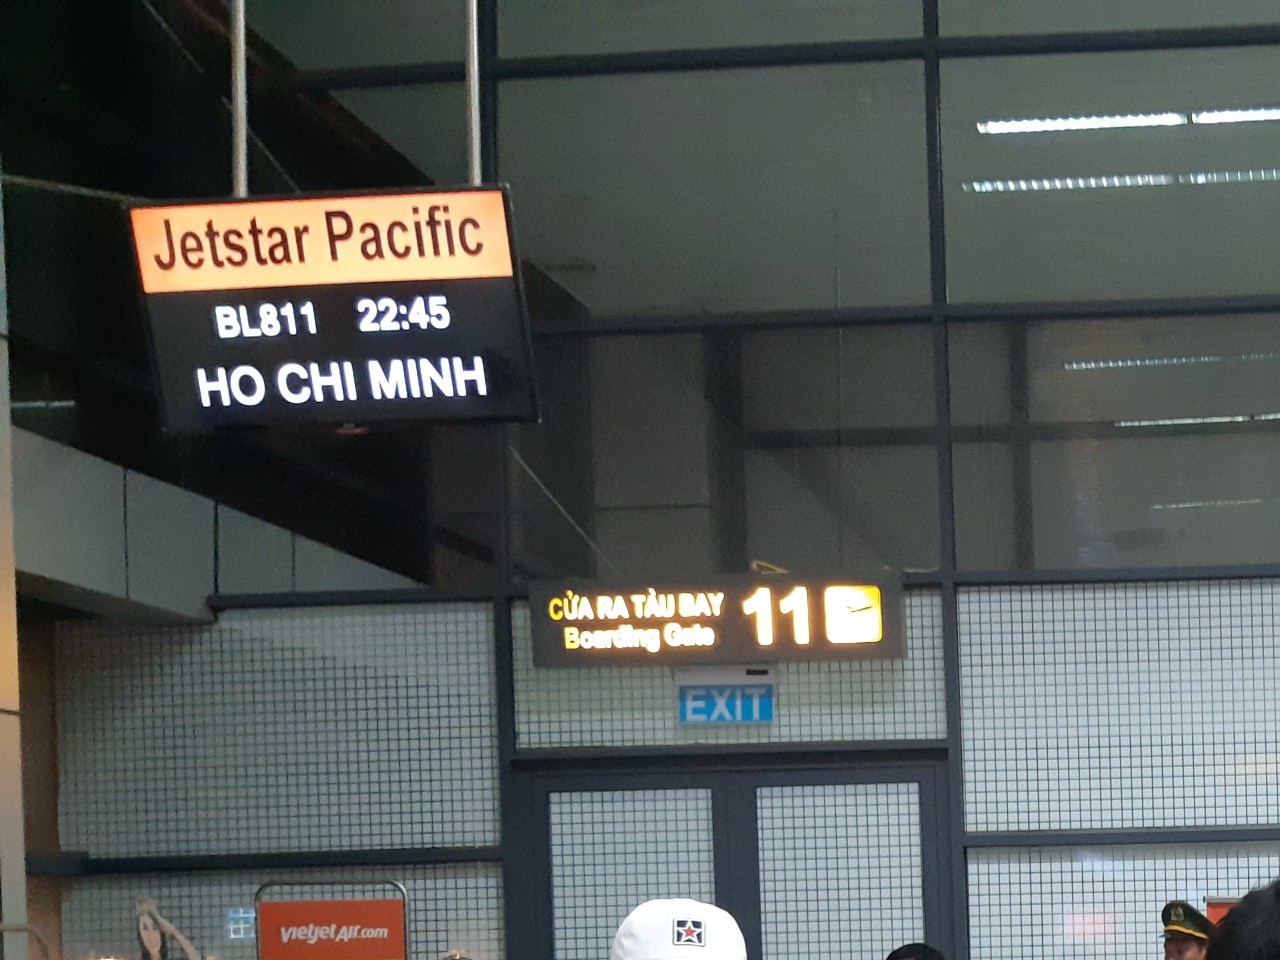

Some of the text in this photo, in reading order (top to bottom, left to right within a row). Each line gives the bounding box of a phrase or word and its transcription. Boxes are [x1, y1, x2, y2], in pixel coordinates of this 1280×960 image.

[154, 205, 484, 272] Jetstar Pacific
[215, 296, 451, 339] BL811 22:45
[197, 356, 488, 408] HO CHI MINH
[597, 595, 630, 620] RA
[631, 587, 676, 619] TÀU
[678, 592, 725, 618] BAY
[742, 586, 810, 646] 11
[564, 622, 715, 653] Boarding Gate
[686, 687, 767, 722] EXIT
